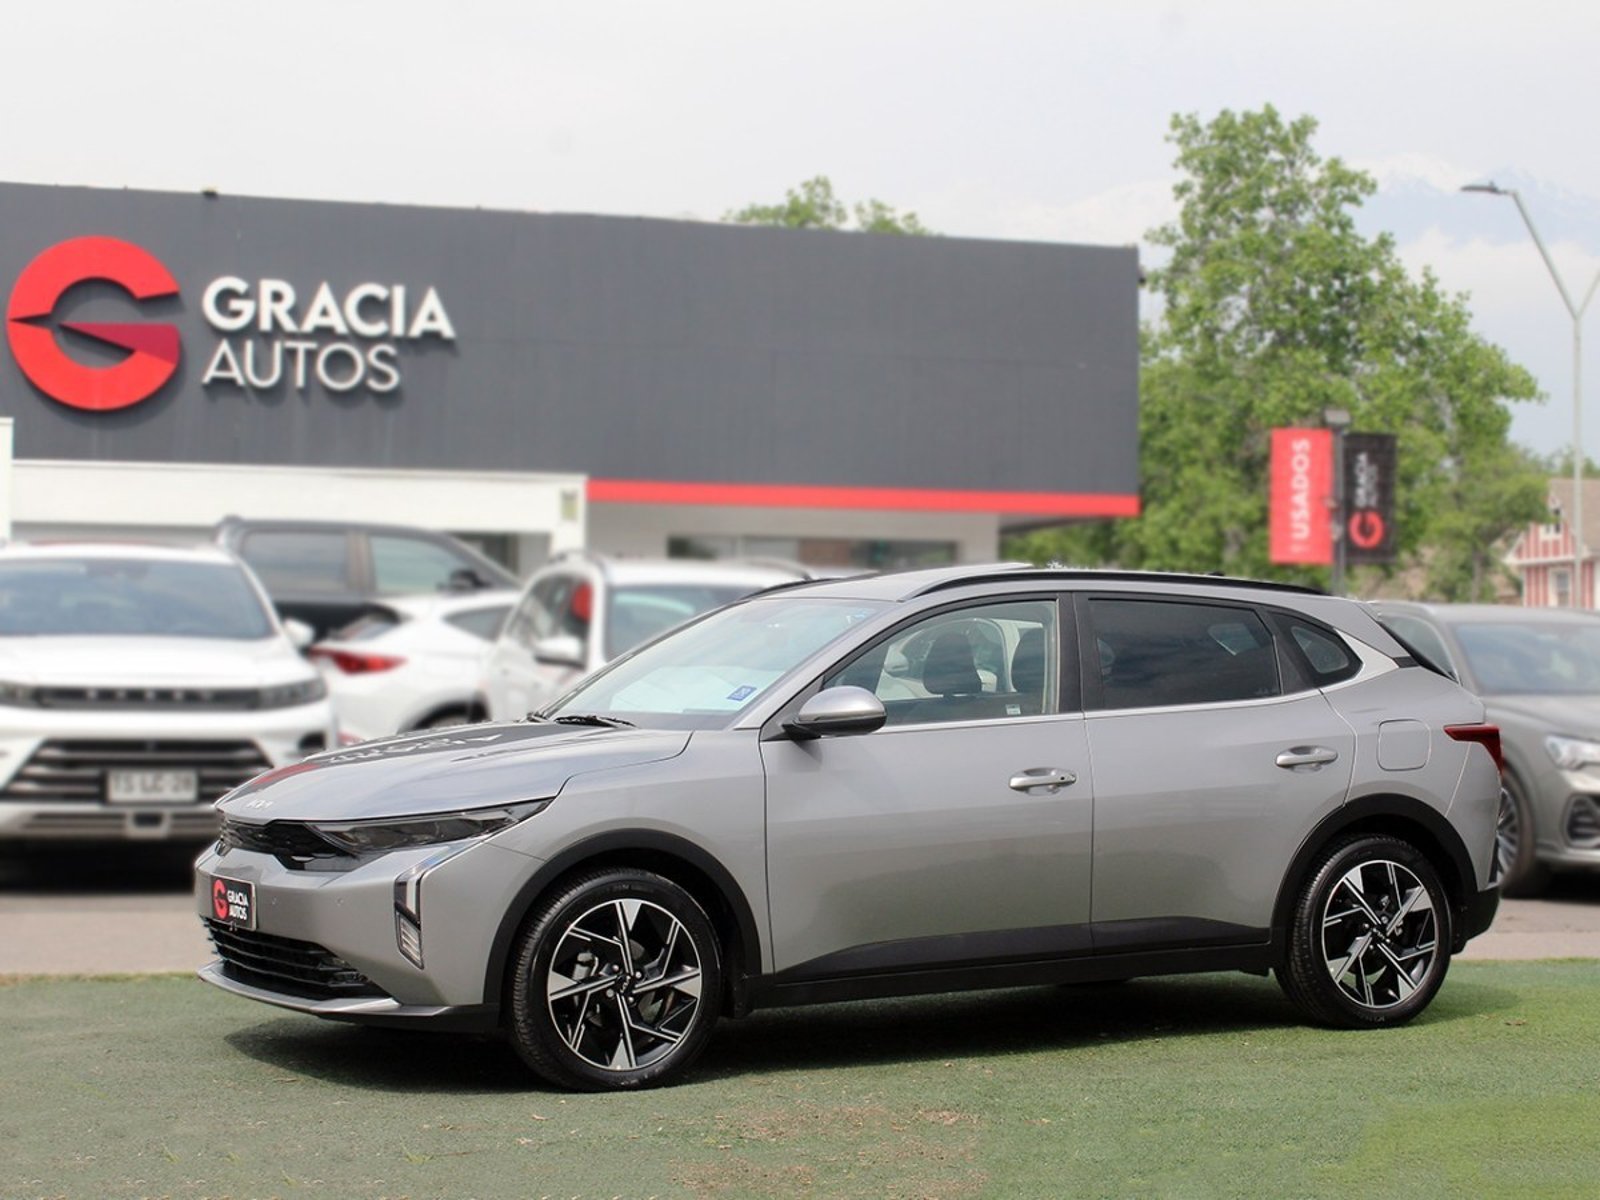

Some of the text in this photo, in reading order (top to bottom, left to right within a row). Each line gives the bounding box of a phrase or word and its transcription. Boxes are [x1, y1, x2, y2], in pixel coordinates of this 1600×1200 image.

[202, 276, 456, 339] GRACIA
[202, 339, 401, 393] AUTOS
[1291, 438, 1310, 540] USADOS
[227, 890, 249, 907] GRACIA
